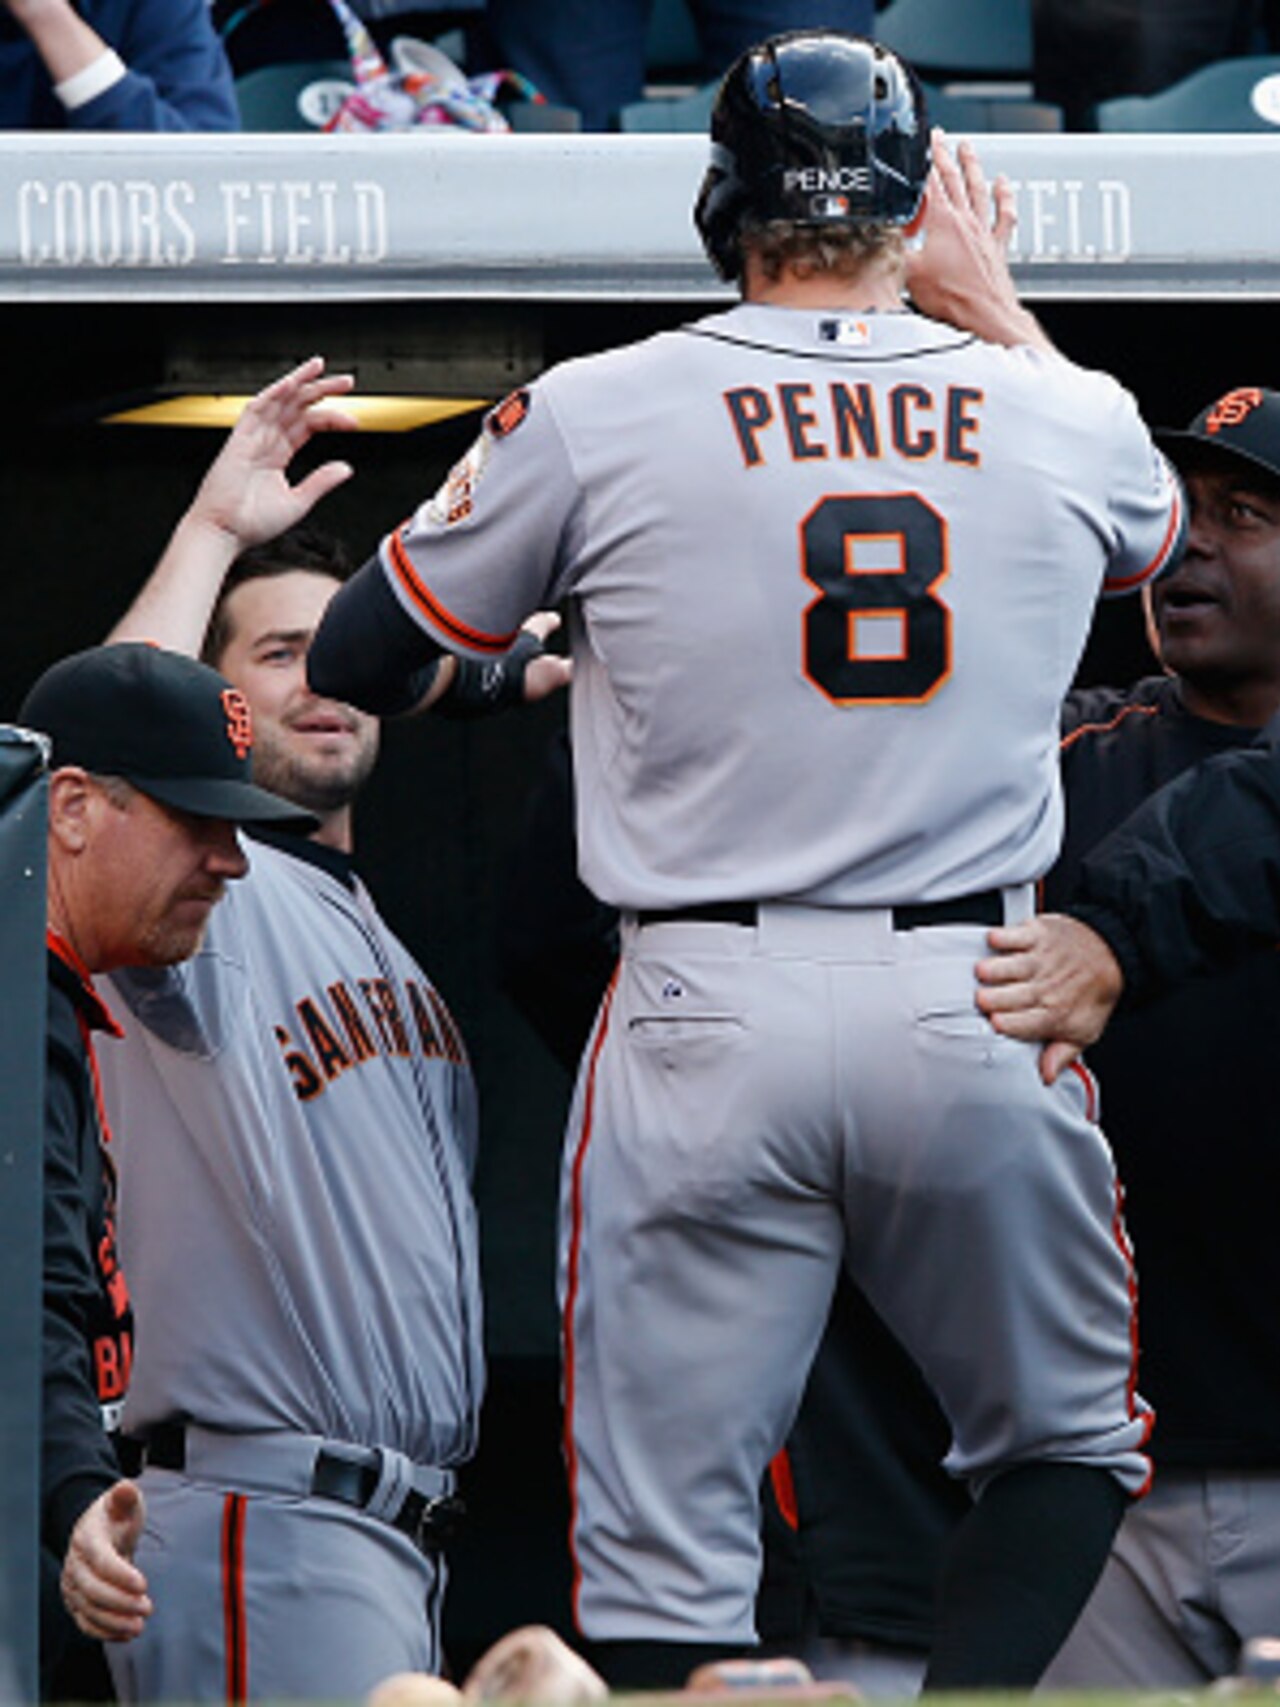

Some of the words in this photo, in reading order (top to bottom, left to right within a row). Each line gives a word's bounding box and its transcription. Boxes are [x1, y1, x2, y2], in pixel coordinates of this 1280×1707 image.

[783, 167, 871, 191] PENCE
[18, 180, 196, 267] COORS
[219, 180, 389, 265] FIELD
[722, 381, 984, 469] PENCE
[798, 490, 953, 708] 8
[273, 976, 379, 1102] SAN
